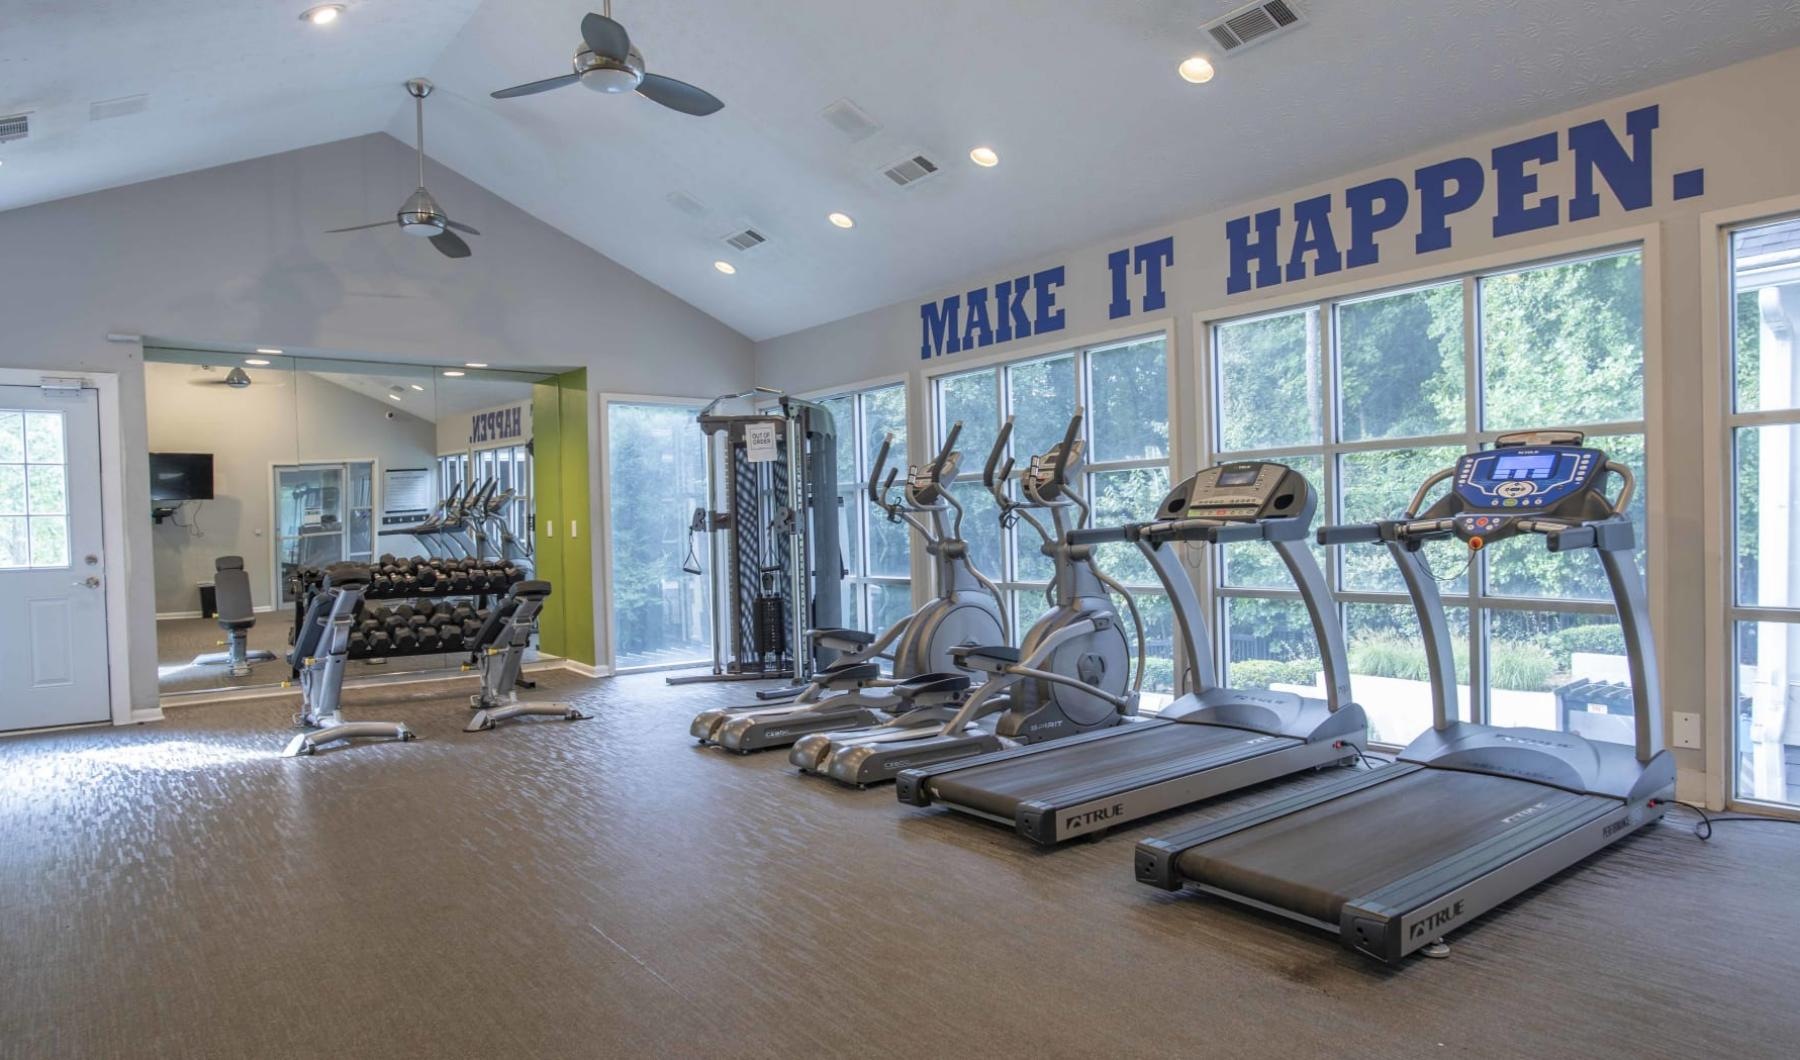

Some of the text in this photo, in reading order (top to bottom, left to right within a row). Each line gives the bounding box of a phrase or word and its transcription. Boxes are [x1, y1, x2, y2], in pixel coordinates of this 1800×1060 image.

[921, 104, 1705, 360] MAKE IT HAPPEN.
[1083, 803, 1124, 824] TRUE
[1425, 899, 1464, 930] TRUE
